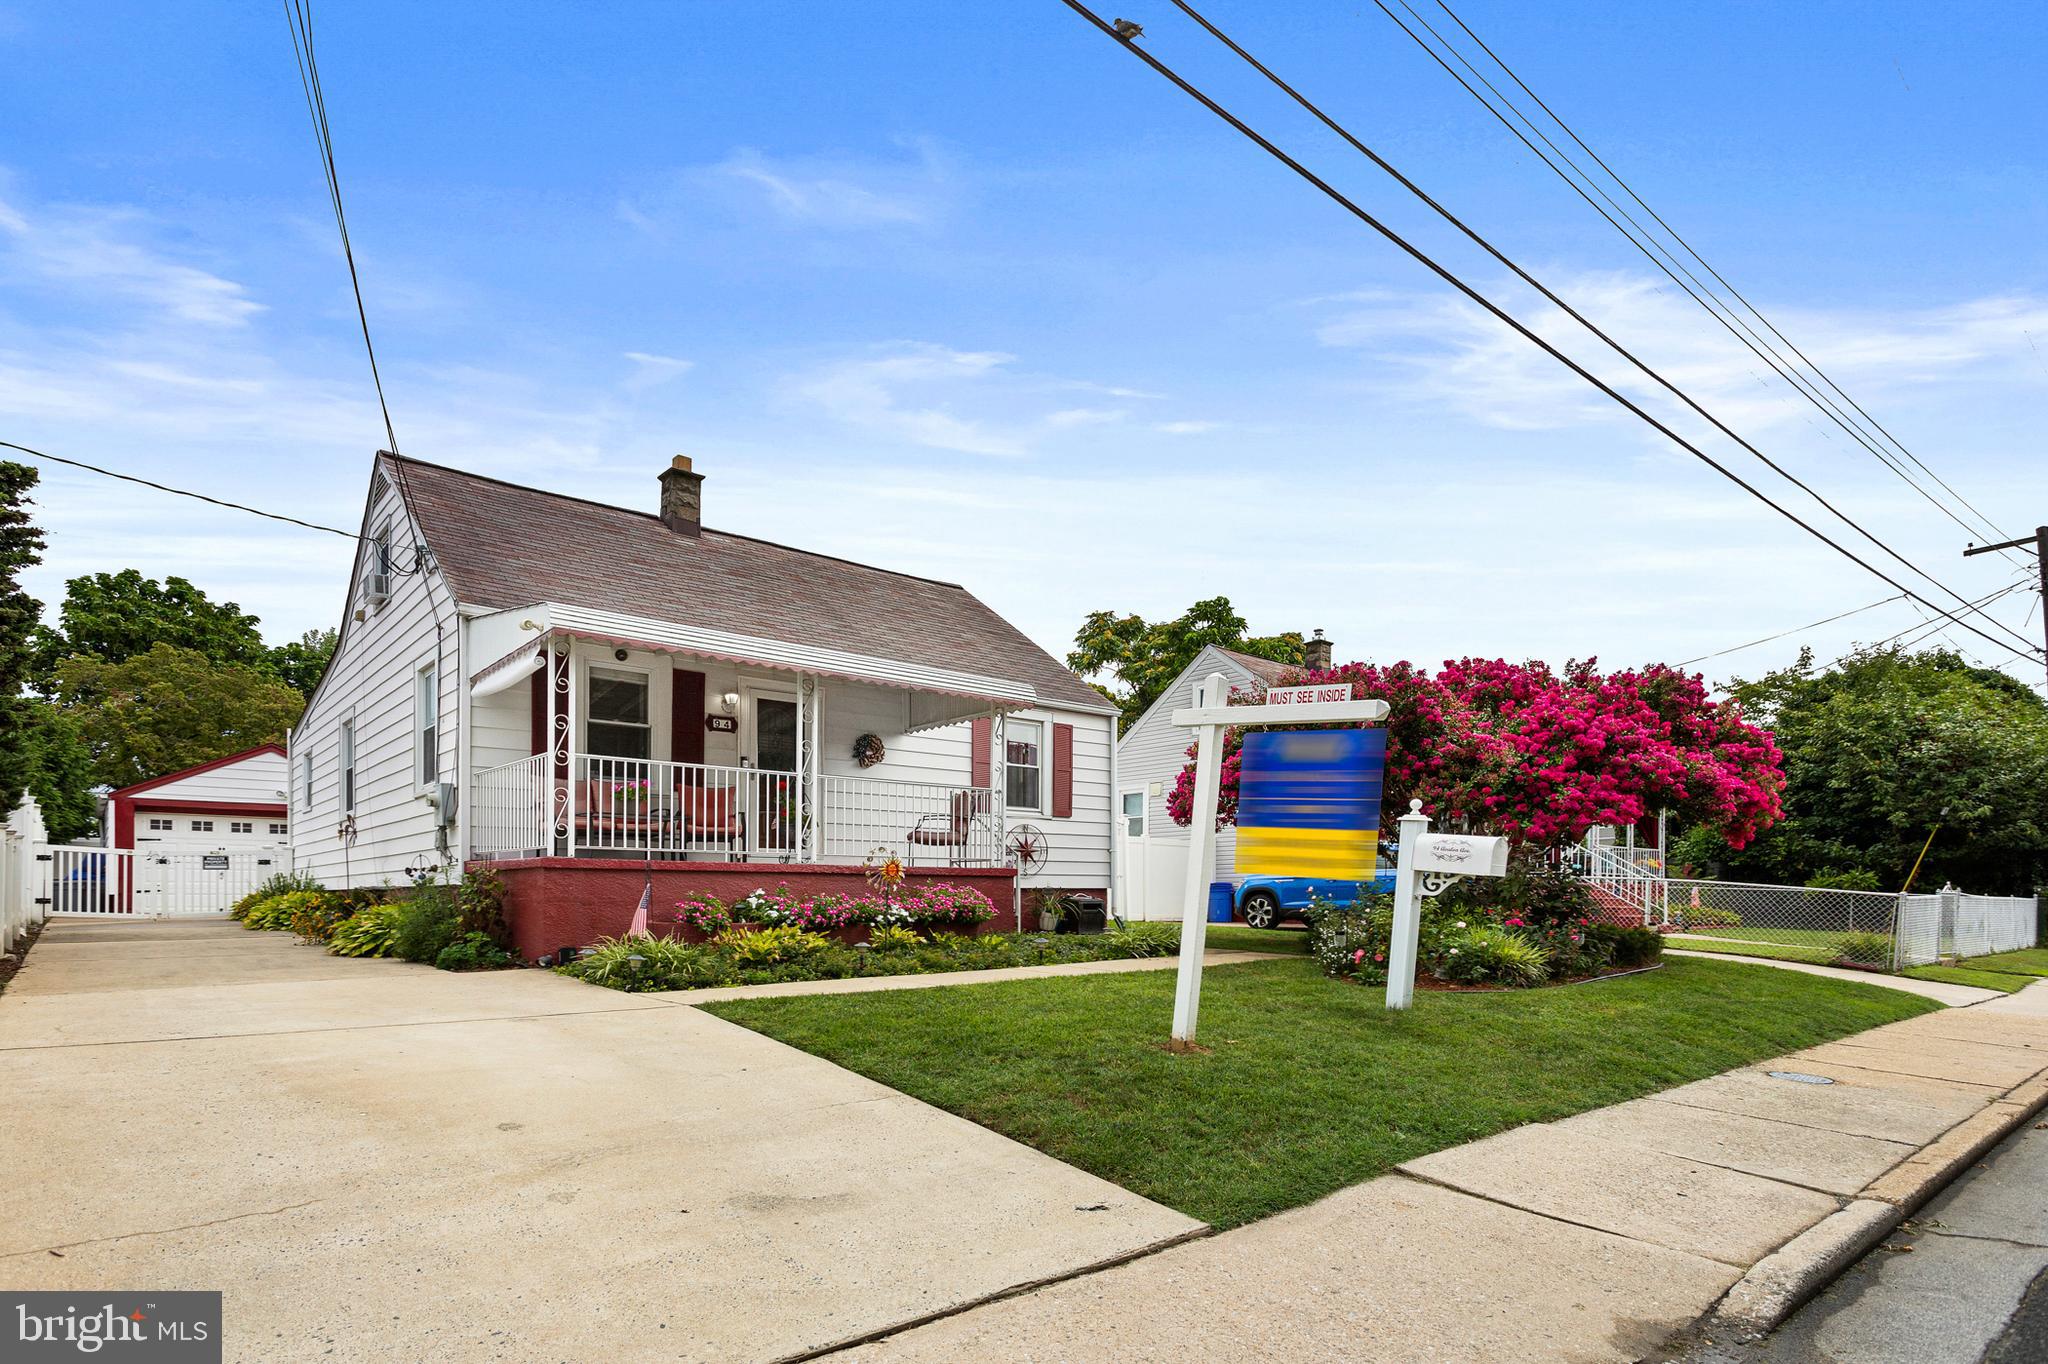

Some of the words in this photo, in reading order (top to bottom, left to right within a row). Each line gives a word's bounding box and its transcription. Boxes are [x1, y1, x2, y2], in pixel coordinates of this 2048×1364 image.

[1270, 692, 1293, 705] MUST
[1296, 690, 1314, 704] SEE
[1317, 689, 1346, 702] INSIDE
